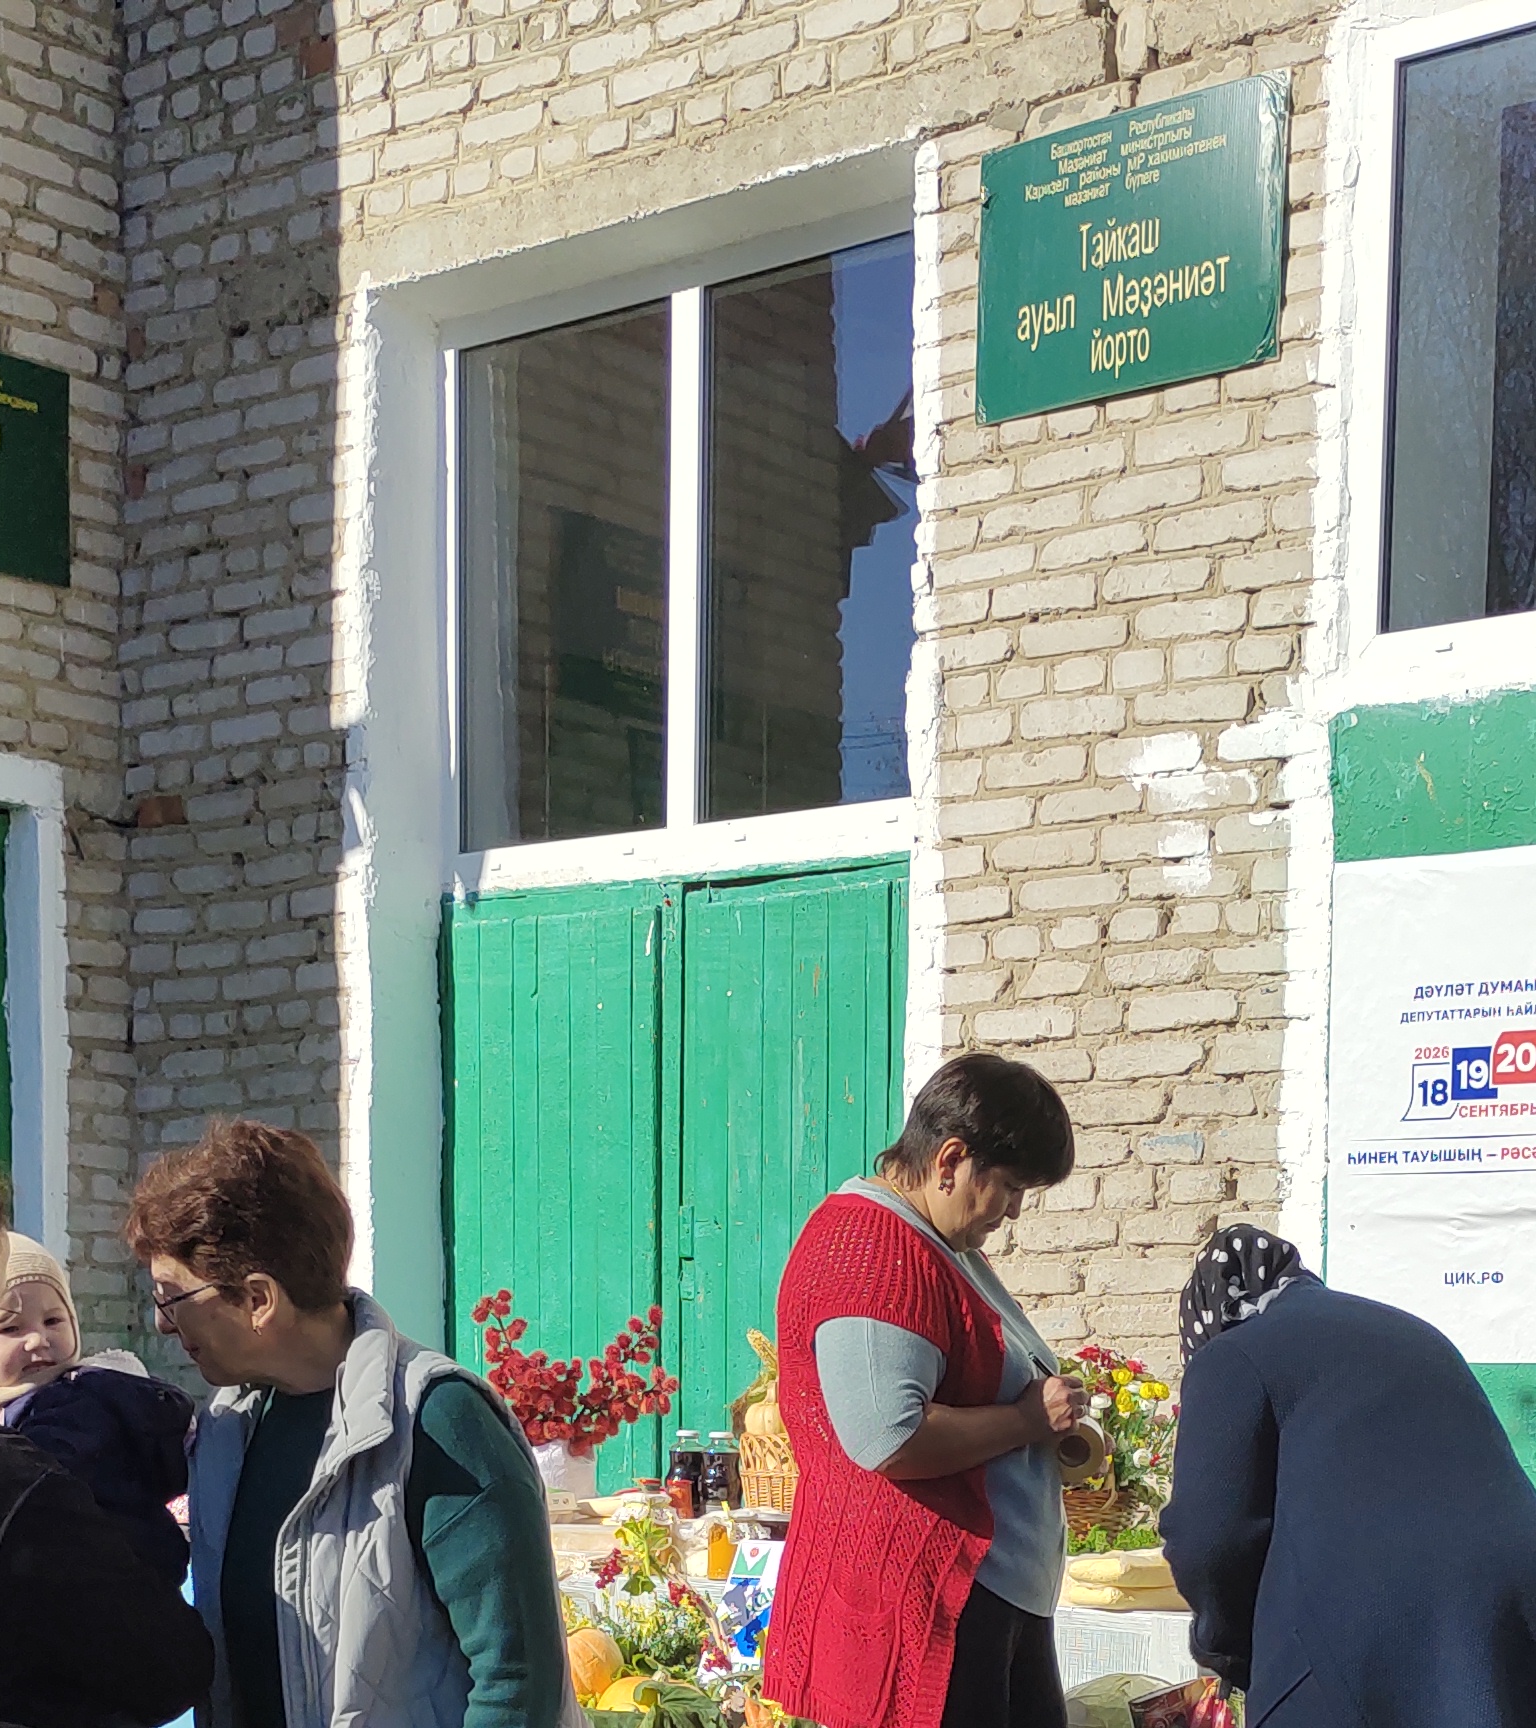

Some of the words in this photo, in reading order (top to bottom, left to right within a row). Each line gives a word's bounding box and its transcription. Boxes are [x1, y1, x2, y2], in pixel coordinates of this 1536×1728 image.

[1126, 152, 1146, 173] МР
[1078, 217, 1161, 272] Тайкаш
[1016, 293, 1076, 352] ауыл
[1089, 326, 1151, 380] йорто
[1400, 1006, 1502, 1025] ДЕПУТАТТАРЫН
[1414, 1046, 1450, 1060] 2026
[1417, 1078, 1449, 1107] 18
[1455, 1059, 1490, 1090] 19
[1443, 1270, 1505, 1288] ЦИК.РФ
